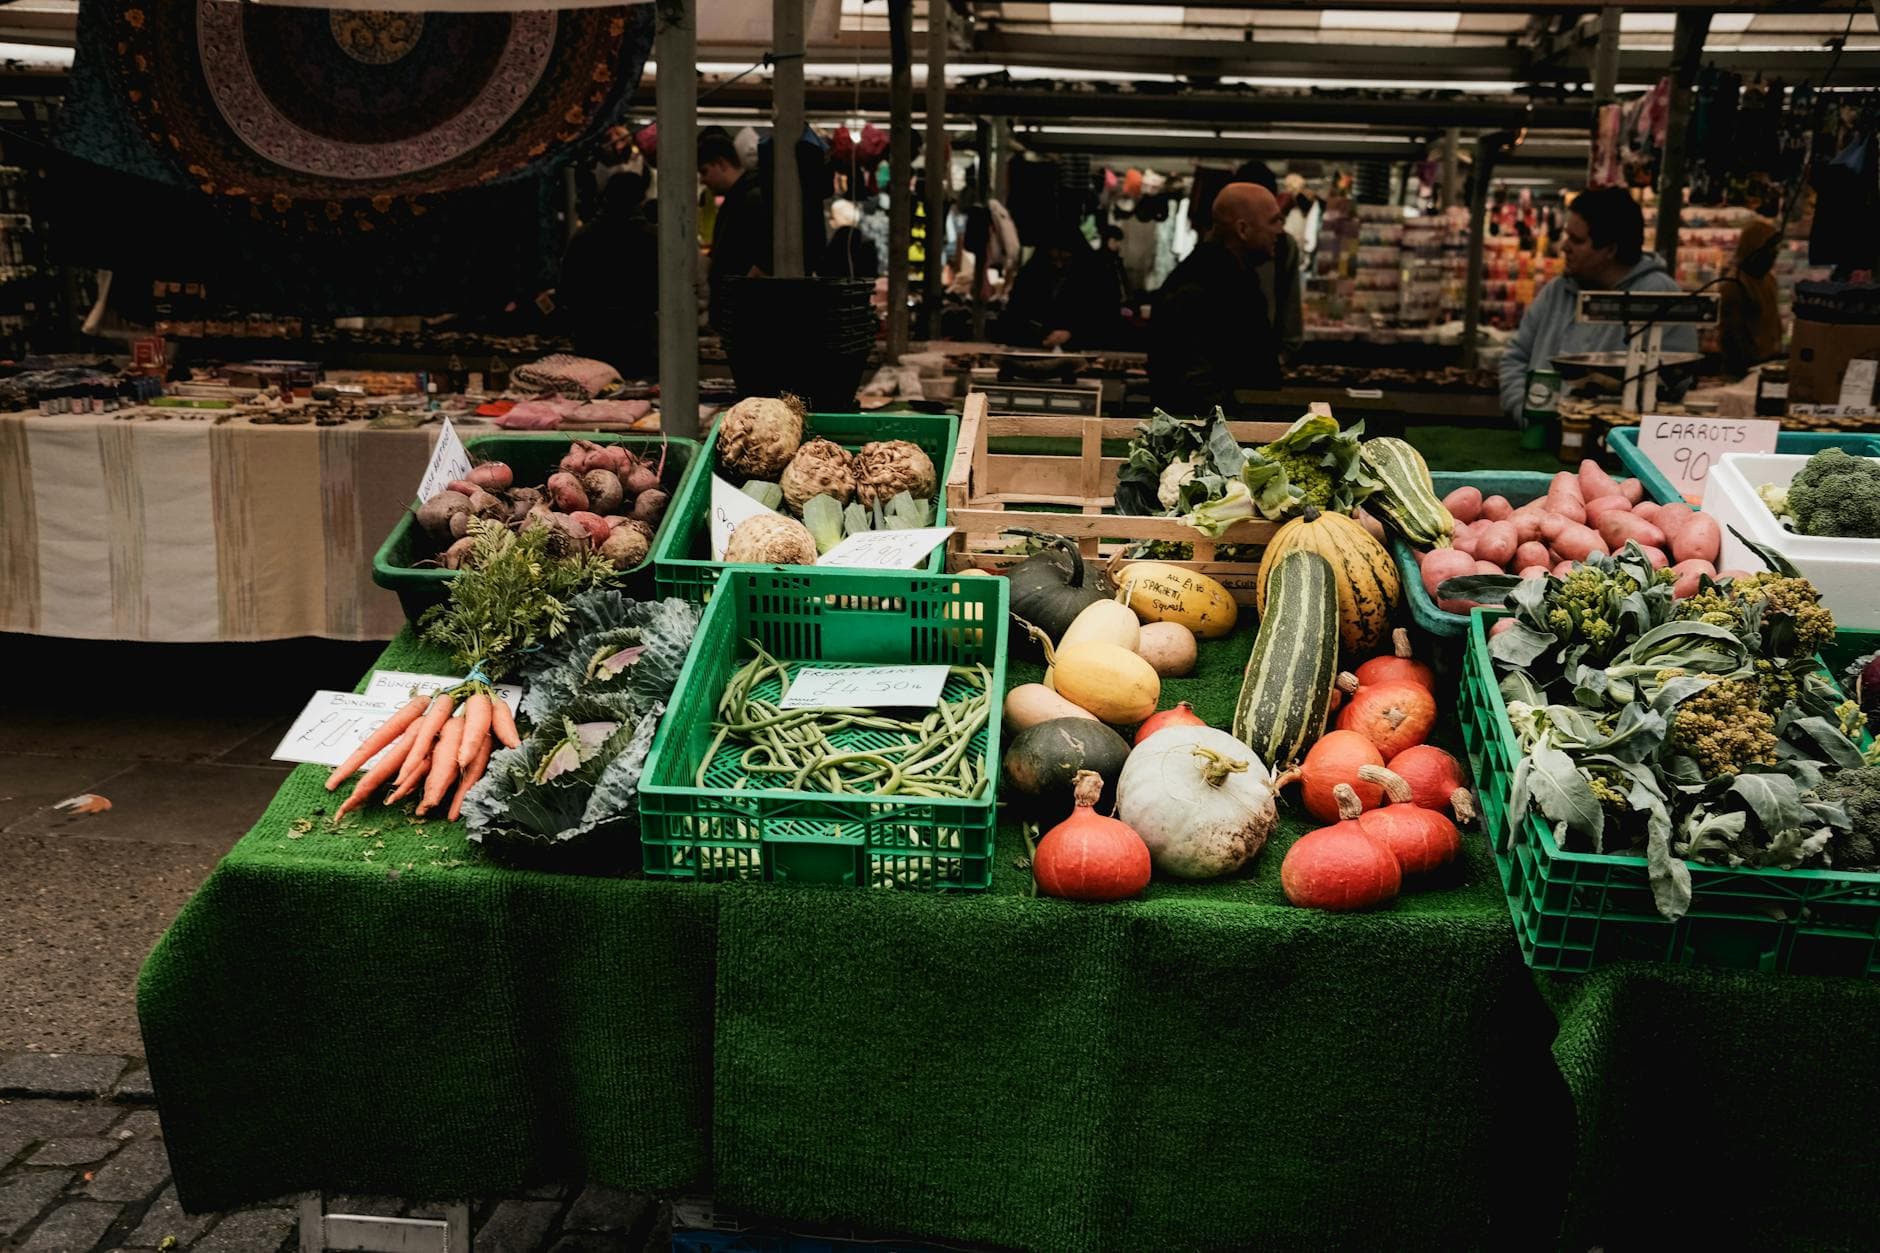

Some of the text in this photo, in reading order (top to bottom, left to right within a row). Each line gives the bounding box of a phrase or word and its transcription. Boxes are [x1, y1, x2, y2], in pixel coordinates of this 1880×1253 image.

[1656, 422, 1747, 443] CARROTS
[1674, 447, 1710, 481] 90
[801, 670, 861, 678] FRENCH
[376, 677, 441, 691] BUNCHED
[330, 695, 387, 709] BUNCHED
